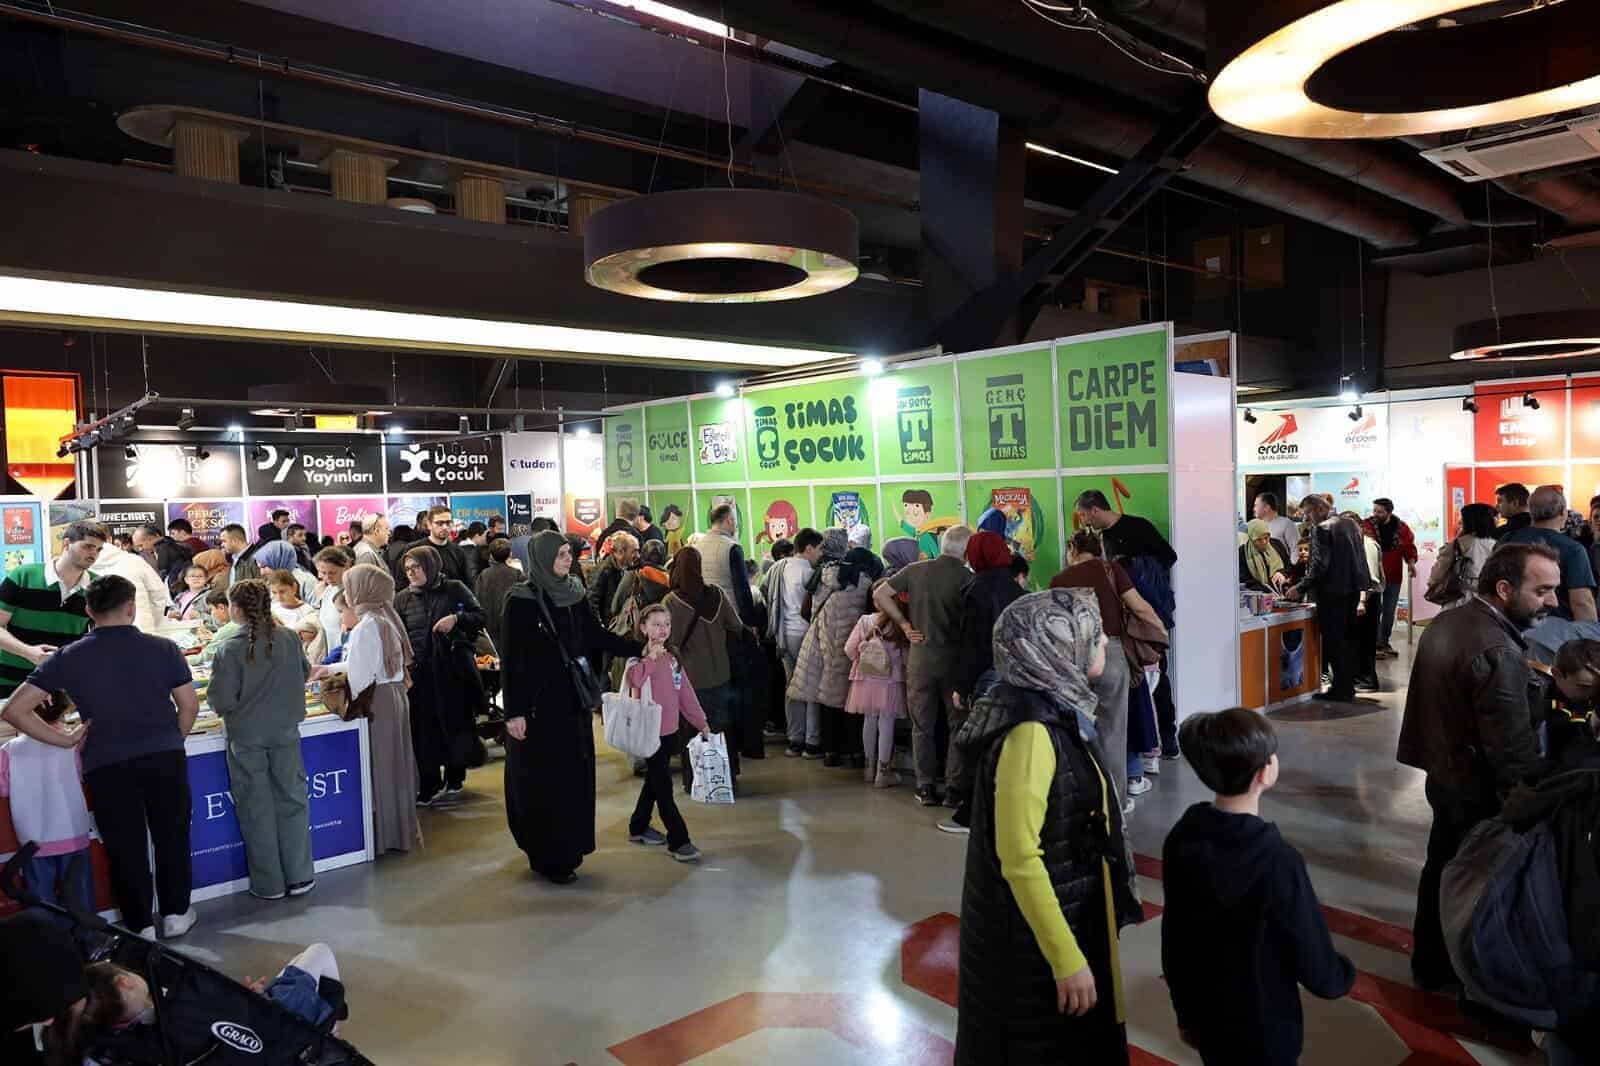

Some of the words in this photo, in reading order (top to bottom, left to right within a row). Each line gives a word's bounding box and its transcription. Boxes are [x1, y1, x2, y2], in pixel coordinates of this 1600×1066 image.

[1068, 361, 1156, 401] CARPE
[649, 431, 688, 450] GÜLCE
[1257, 442, 1298, 455] erdem
[303, 453, 355, 472] Doğan
[435, 451, 489, 469] Doğan
[784, 434, 865, 472] ÇOCUK
[520, 459, 556, 469] tudem
[303, 469, 373, 487] Yayınları
[434, 467, 485, 486] Çocuk
[220, 1025, 259, 1050] GRACO
